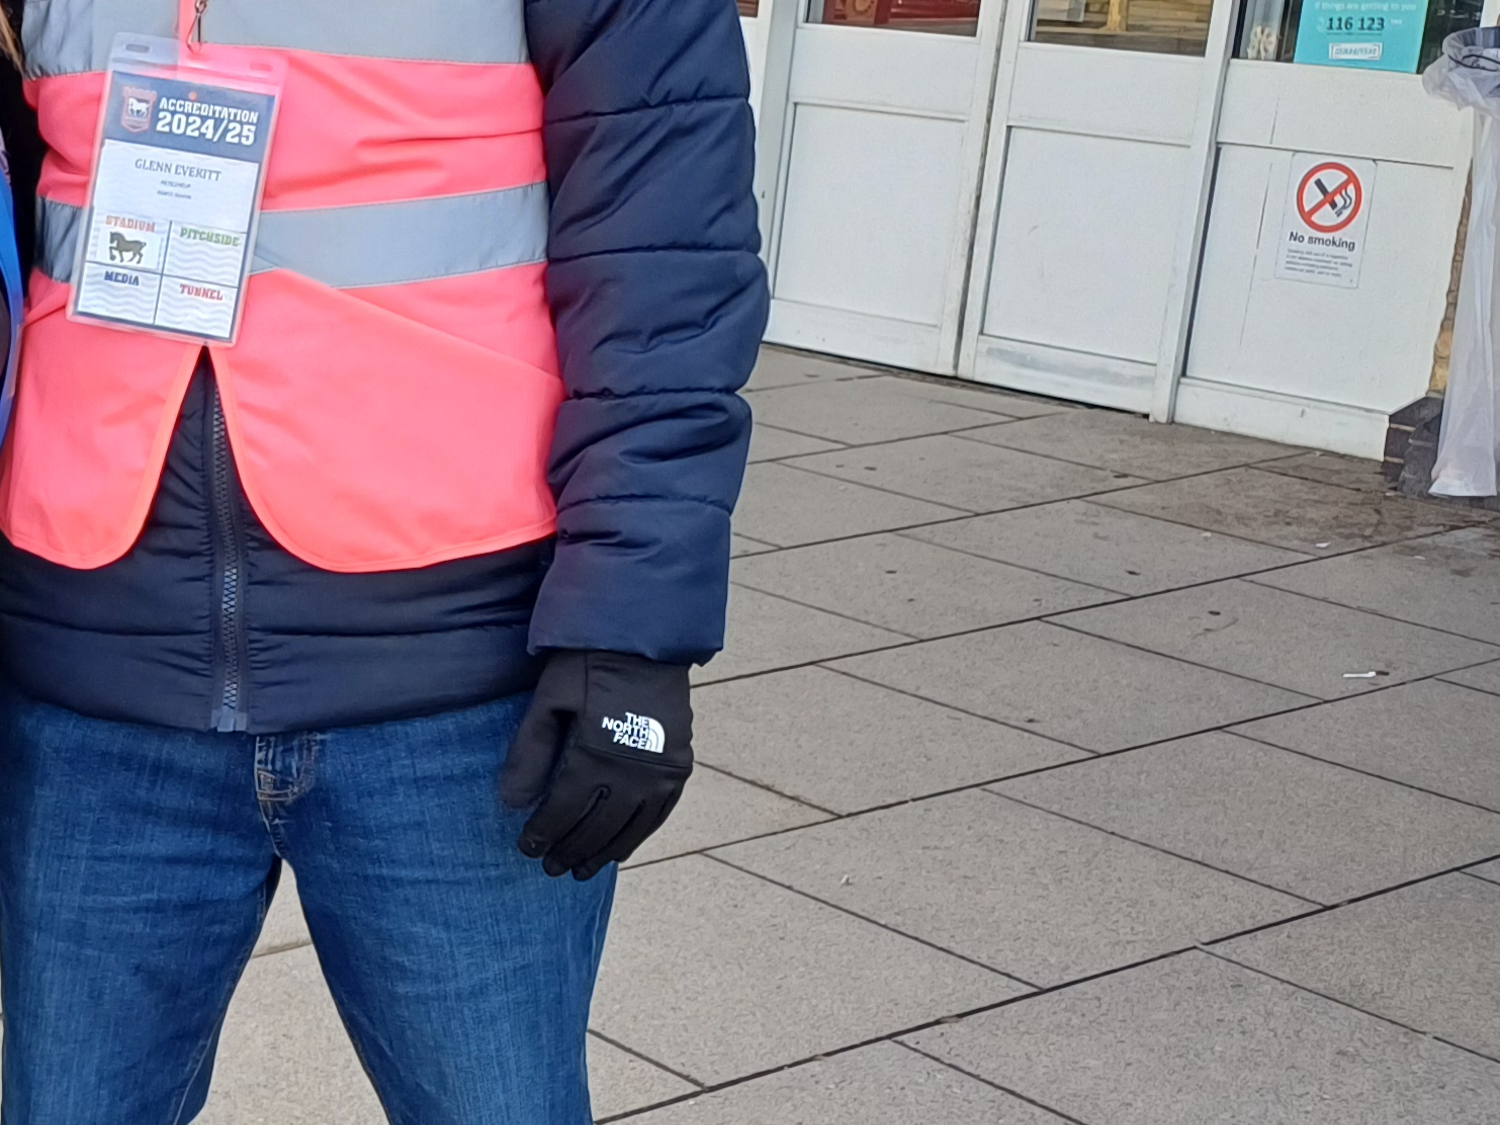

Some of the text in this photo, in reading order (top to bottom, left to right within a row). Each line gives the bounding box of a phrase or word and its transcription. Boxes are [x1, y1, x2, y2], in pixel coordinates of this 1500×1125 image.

[1326, 16, 1354, 31] 116
[1357, 16, 1385, 31] 123
[159, 97, 259, 124] ACCREDITATION
[156, 111, 257, 146] 2024/25
[134, 158, 173, 174] GLENN
[105, 215, 157, 233] STADIUM
[179, 227, 241, 247] PITCHSIDE
[1288, 231, 1356, 252] No smoking
[103, 270, 140, 287] MEDIA
[179, 284, 224, 301] TUNNEL
[602, 716, 649, 740] NORTH
[625, 712, 649, 728] THE
[613, 732, 646, 750] FACE
